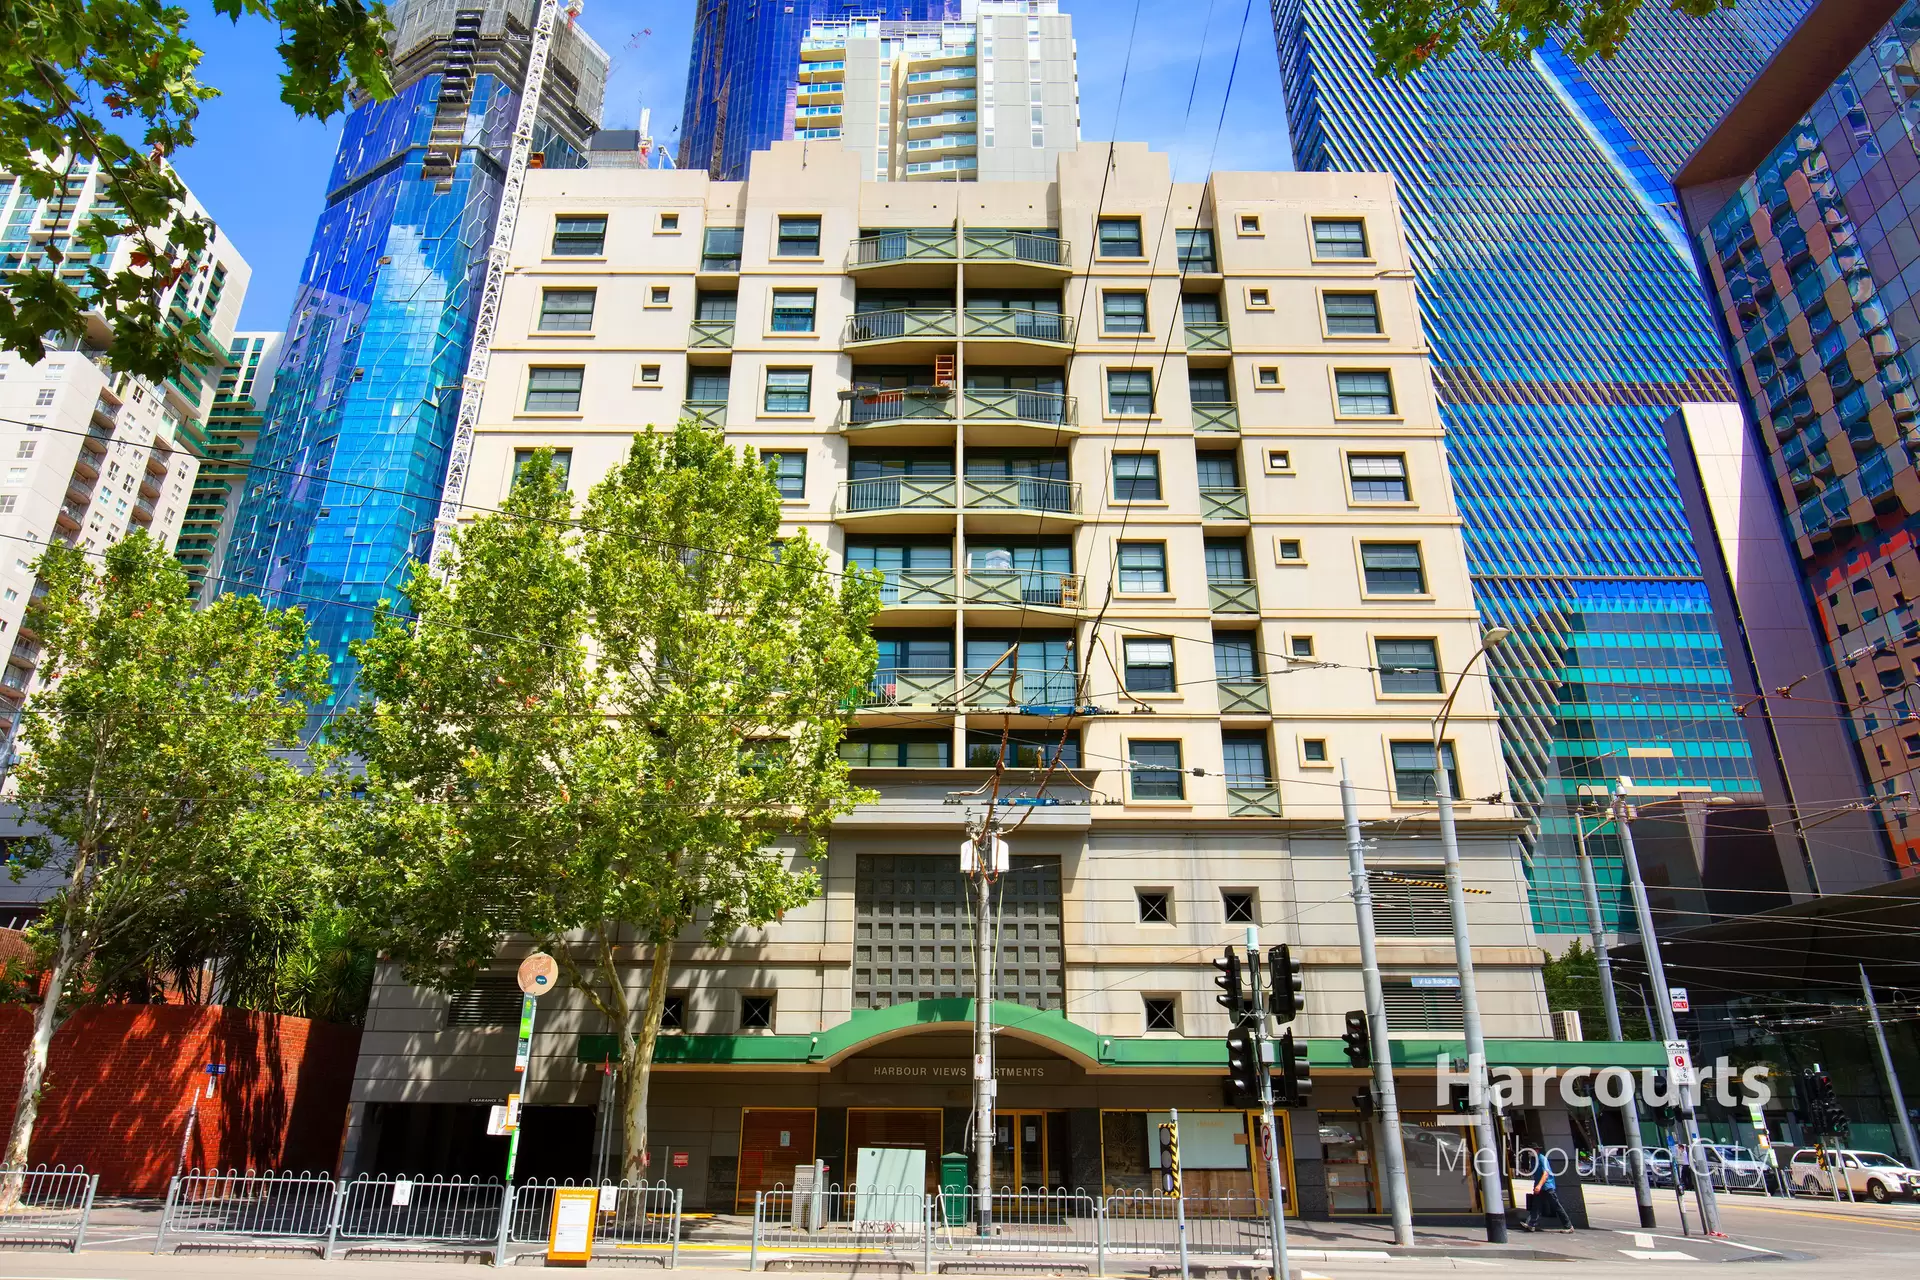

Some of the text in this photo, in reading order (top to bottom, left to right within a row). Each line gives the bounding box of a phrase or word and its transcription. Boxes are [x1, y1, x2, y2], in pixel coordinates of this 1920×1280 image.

[1673, 1001, 1687, 1009] ONLY
[873, 1066, 927, 1077] HARBOUR
[932, 1067, 967, 1077] VIEWS
